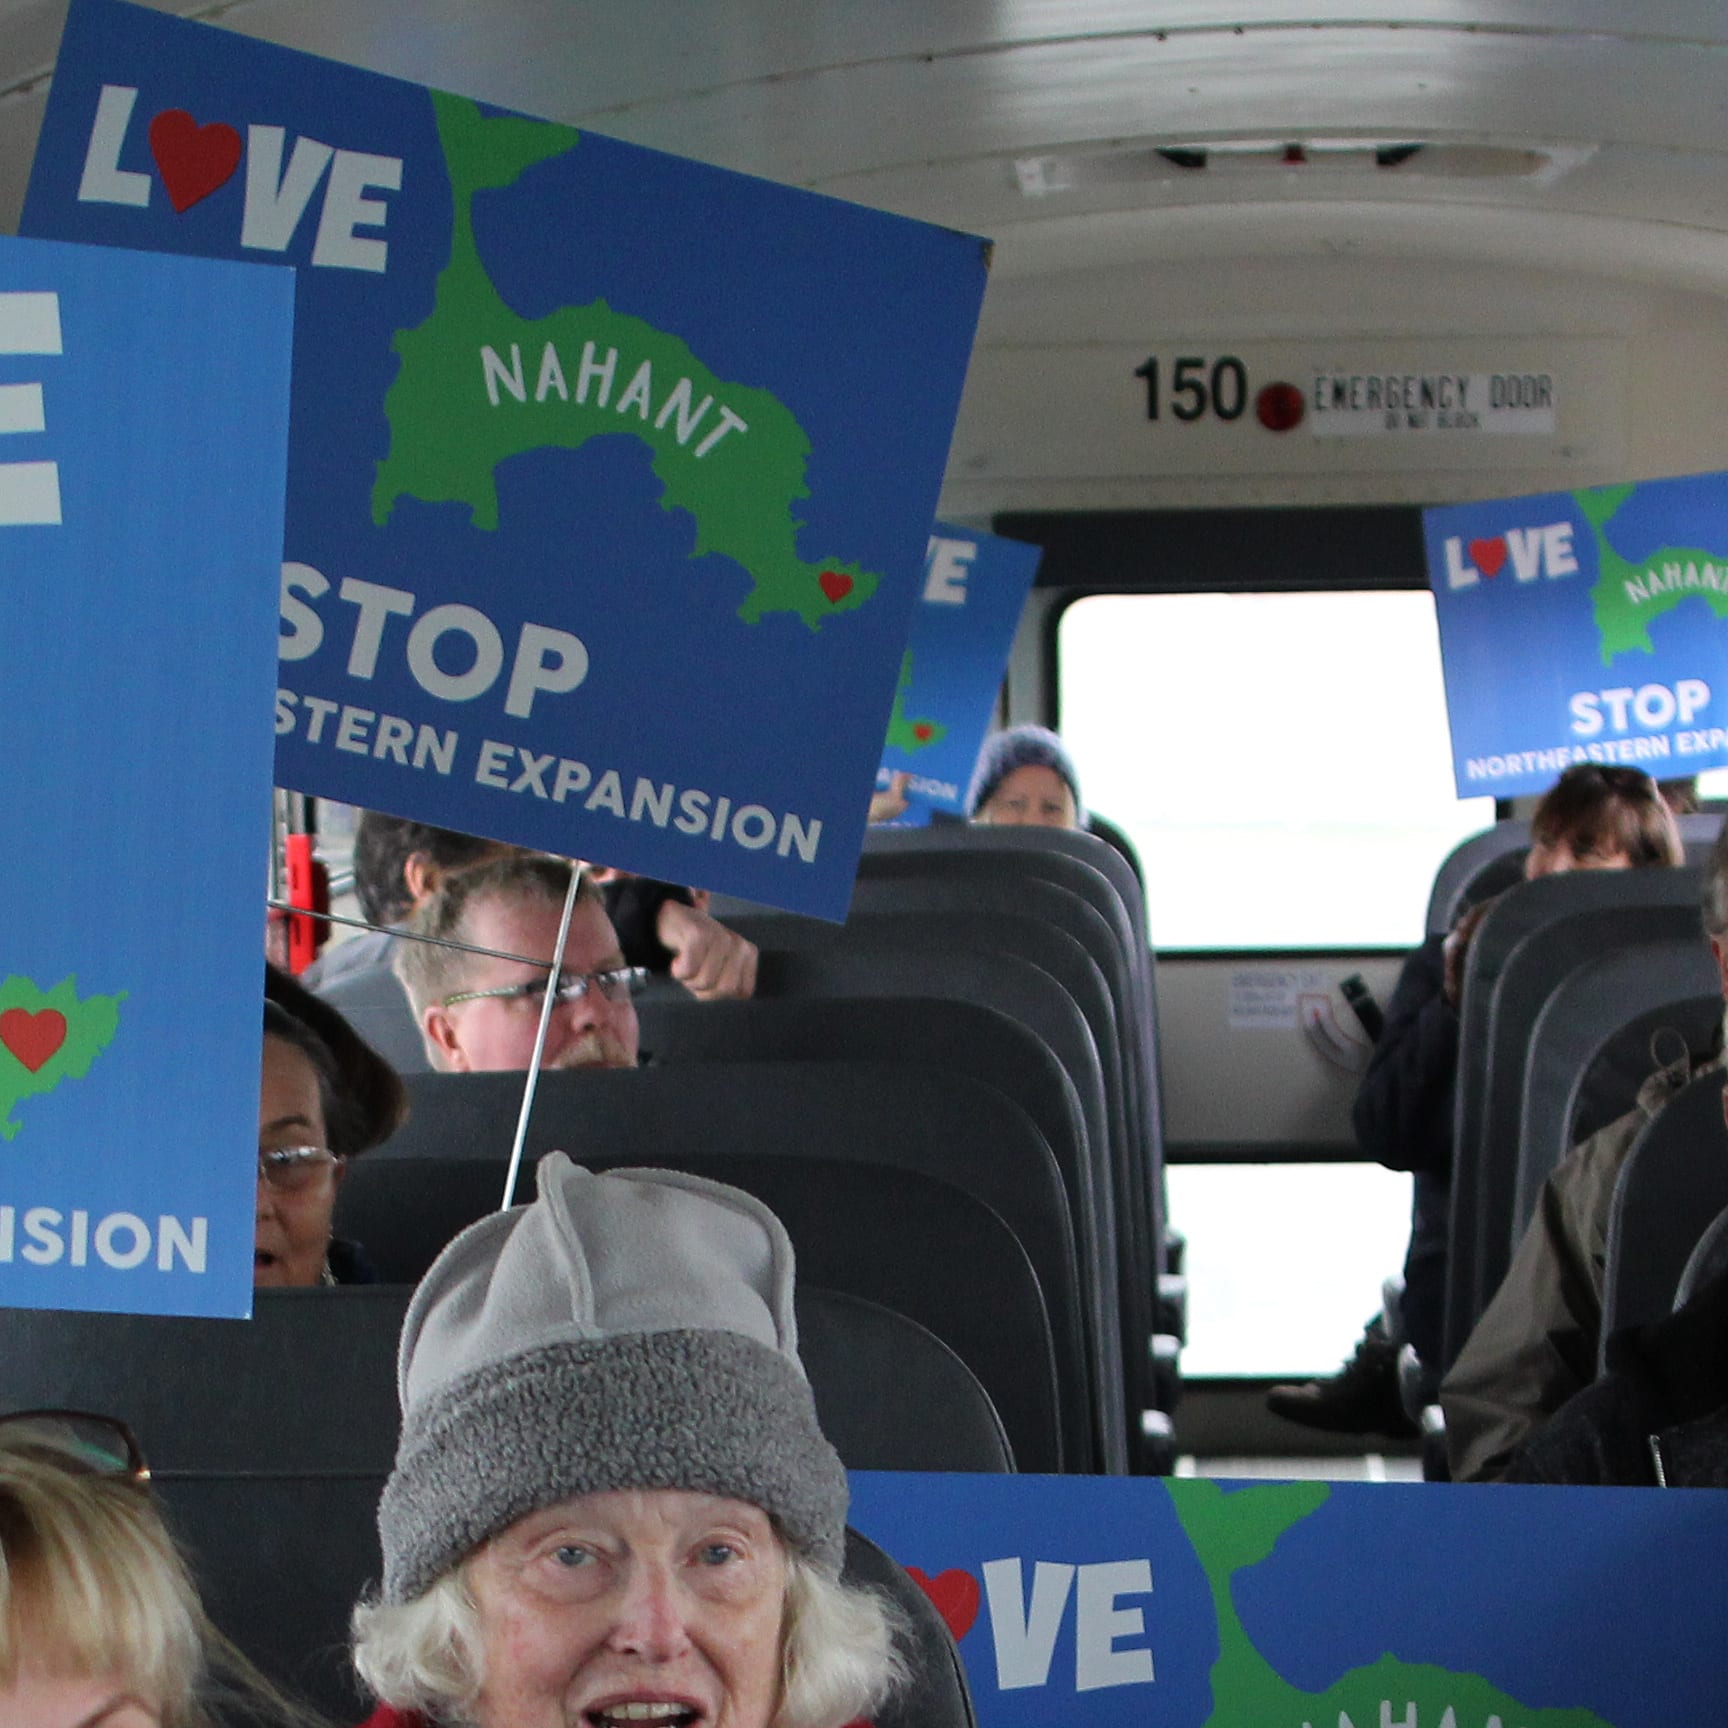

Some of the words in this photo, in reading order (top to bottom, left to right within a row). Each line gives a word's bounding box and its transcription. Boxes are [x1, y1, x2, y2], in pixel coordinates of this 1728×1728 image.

[480, 340, 748, 458] NAHANT
[1134, 356, 1248, 421] 150
[1313, 374, 1470, 412] EMERGENCY
[1489, 373, 1553, 410] DOOR
[278, 561, 589, 719] STOP
[1569, 679, 1712, 738] STOP
[275, 688, 459, 775] STERN
[475, 739, 823, 863] EXPANSION
[1465, 734, 1671, 779] NORTHEASTERN
